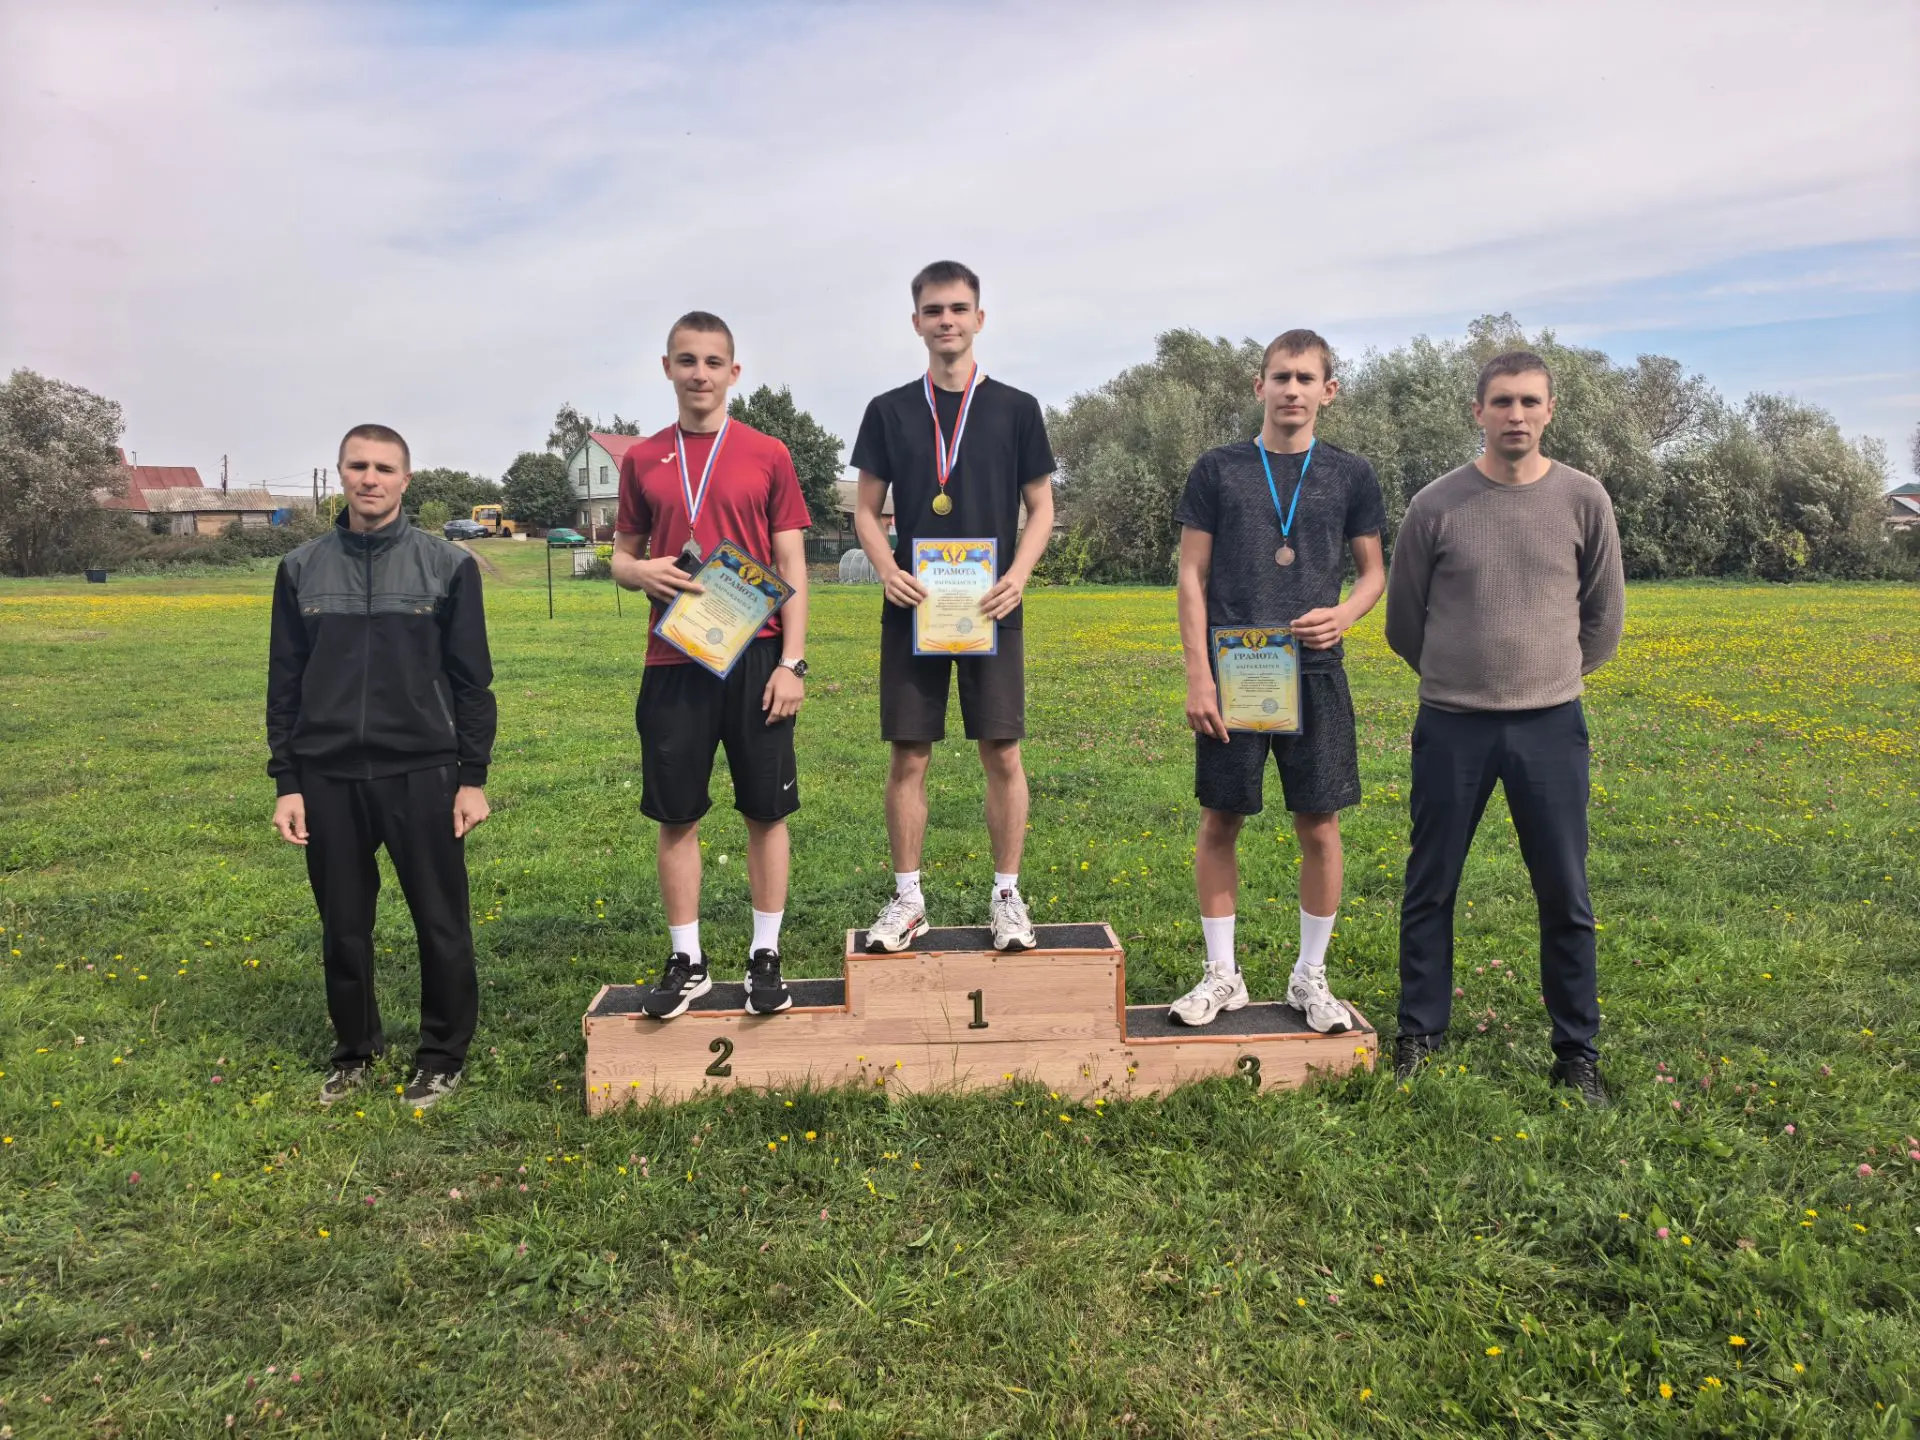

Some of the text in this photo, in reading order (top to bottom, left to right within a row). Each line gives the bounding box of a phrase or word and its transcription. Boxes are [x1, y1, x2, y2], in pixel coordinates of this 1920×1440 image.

[719, 572, 758, 603] ГРАМОТА
[932, 567, 976, 576] ГРАМОТА
[1234, 652, 1279, 660] ГРАМОТА
[967, 988, 989, 1030] 1
[705, 1037, 733, 1077] 2
[1237, 1054, 1262, 1092] 3
